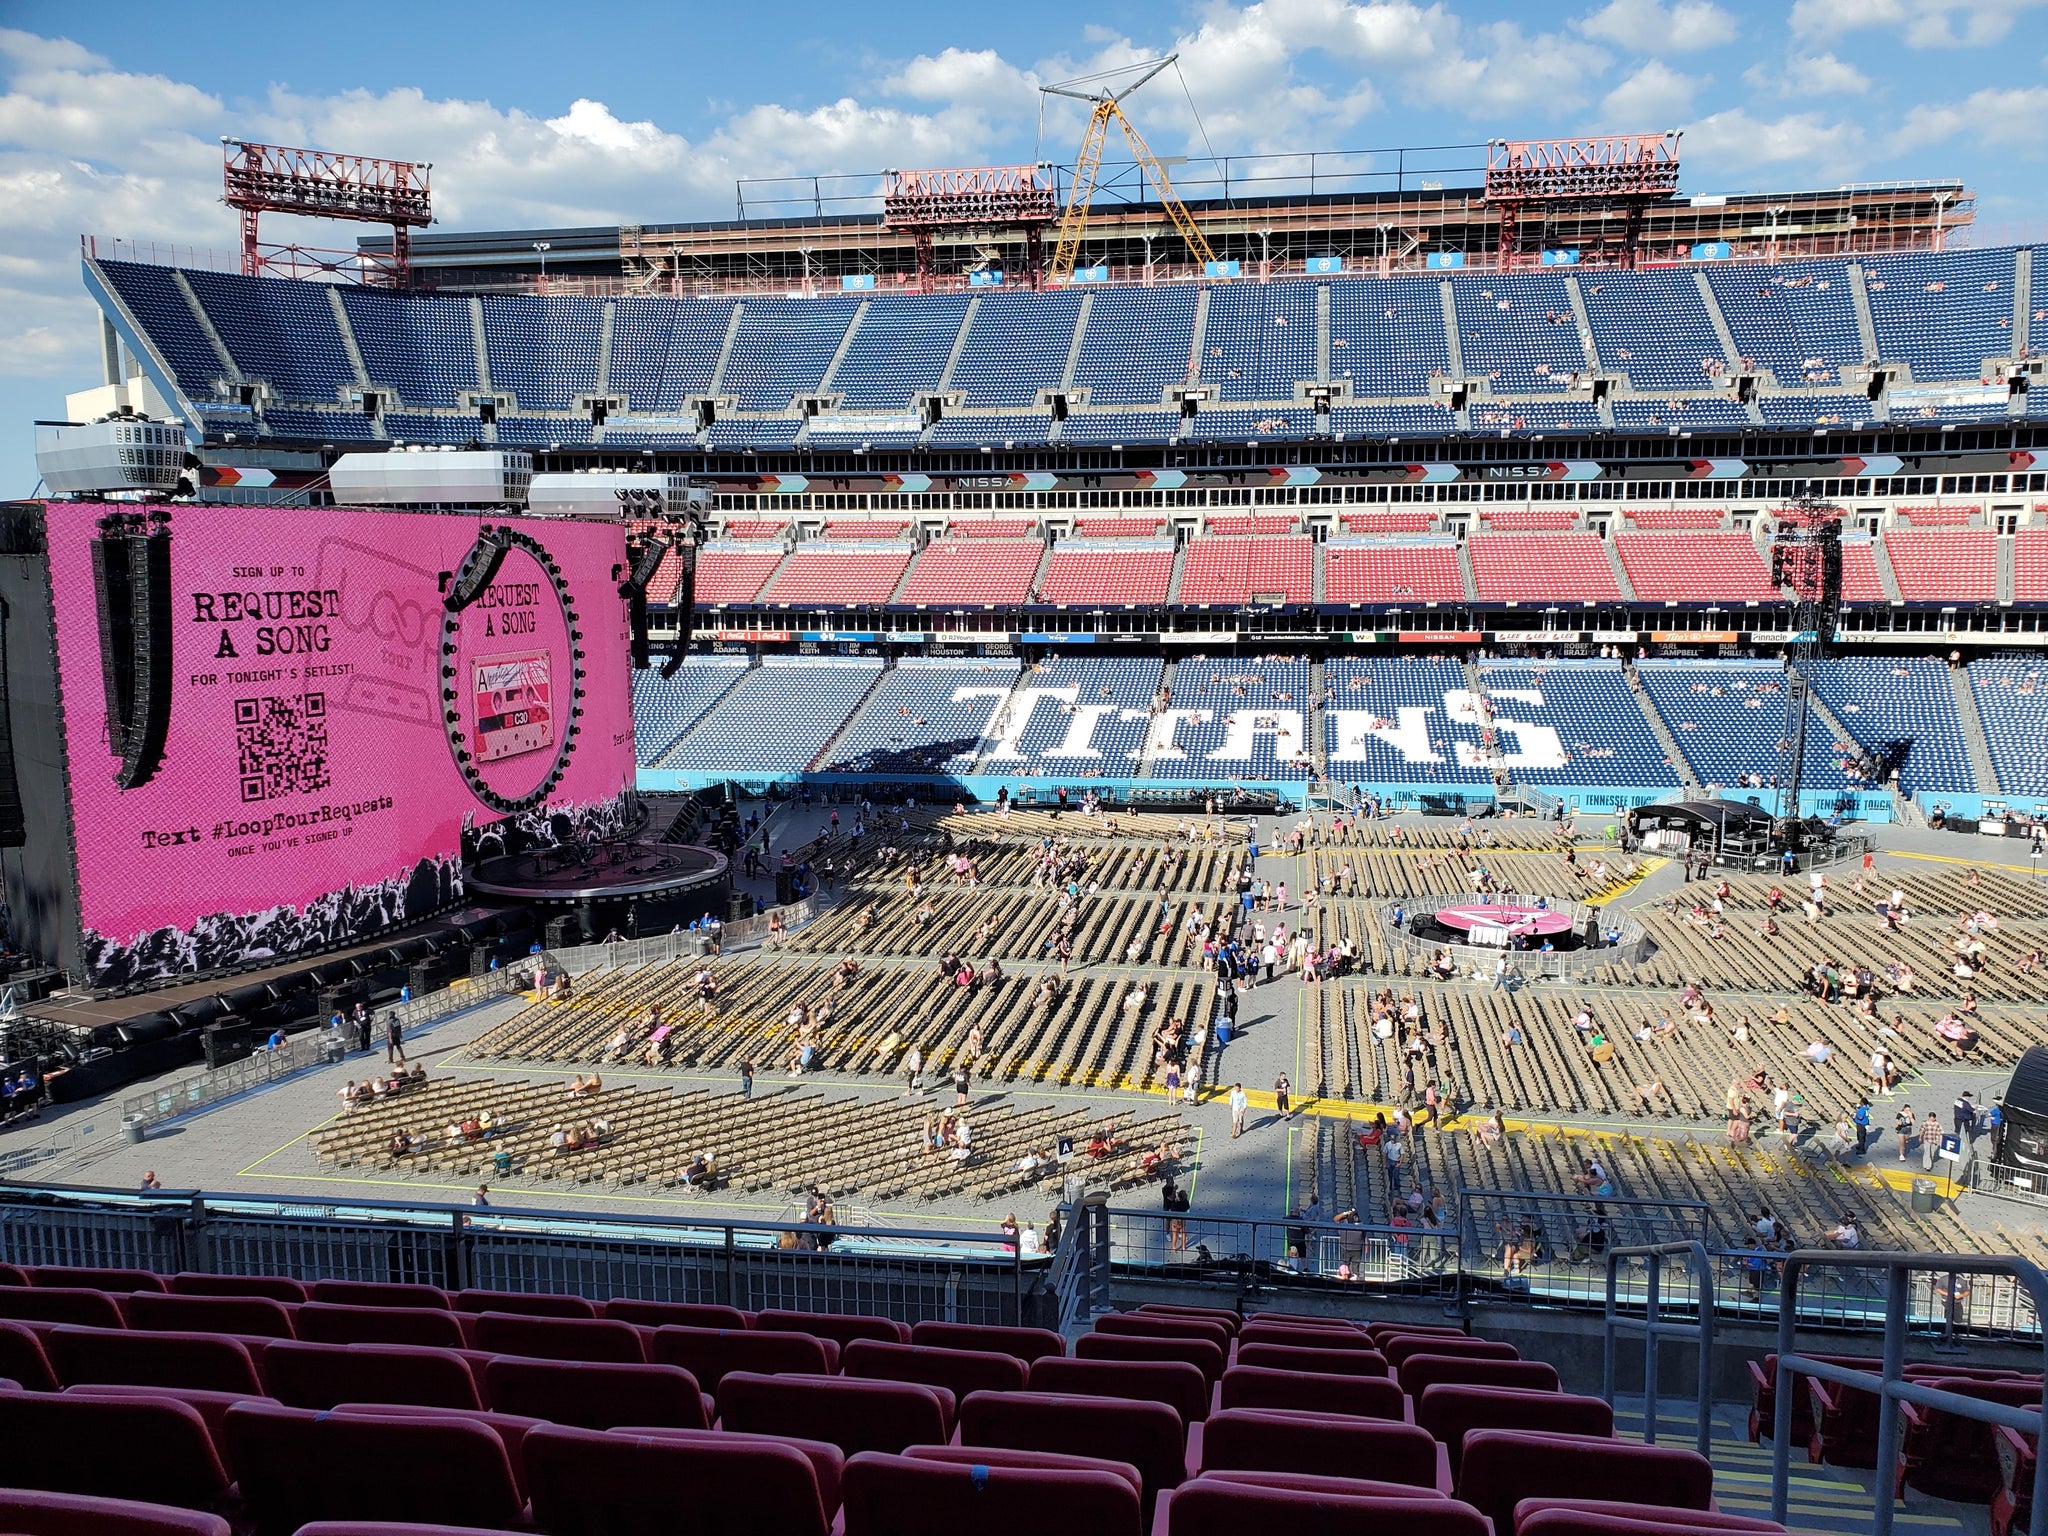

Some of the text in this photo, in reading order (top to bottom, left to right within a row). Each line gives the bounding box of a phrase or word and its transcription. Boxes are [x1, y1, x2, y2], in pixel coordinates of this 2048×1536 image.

[233, 566, 304, 578] SIGN UP TO
[192, 590, 339, 622] REQUEST
[485, 611, 536, 637] A SONG
[214, 625, 331, 658] A SONG
[1752, 634, 1788, 642] Pinnacle
[1992, 651, 2045, 660] TITANS
[191, 663, 355, 686] FOR TONIGHT'S SETLIST!
[478, 669, 488, 692] A
[514, 711, 529, 725] C30
[951, 687, 1568, 767] TITANS
[1585, 794, 1628, 806] TENNESSEE
[141, 795, 393, 848] Text #LoopTourRequests
[227, 827, 353, 857] ONCE YOU'VE SIGNED UP
[1063, 1142, 1070, 1153] A
[1946, 1140, 1956, 1151] F
